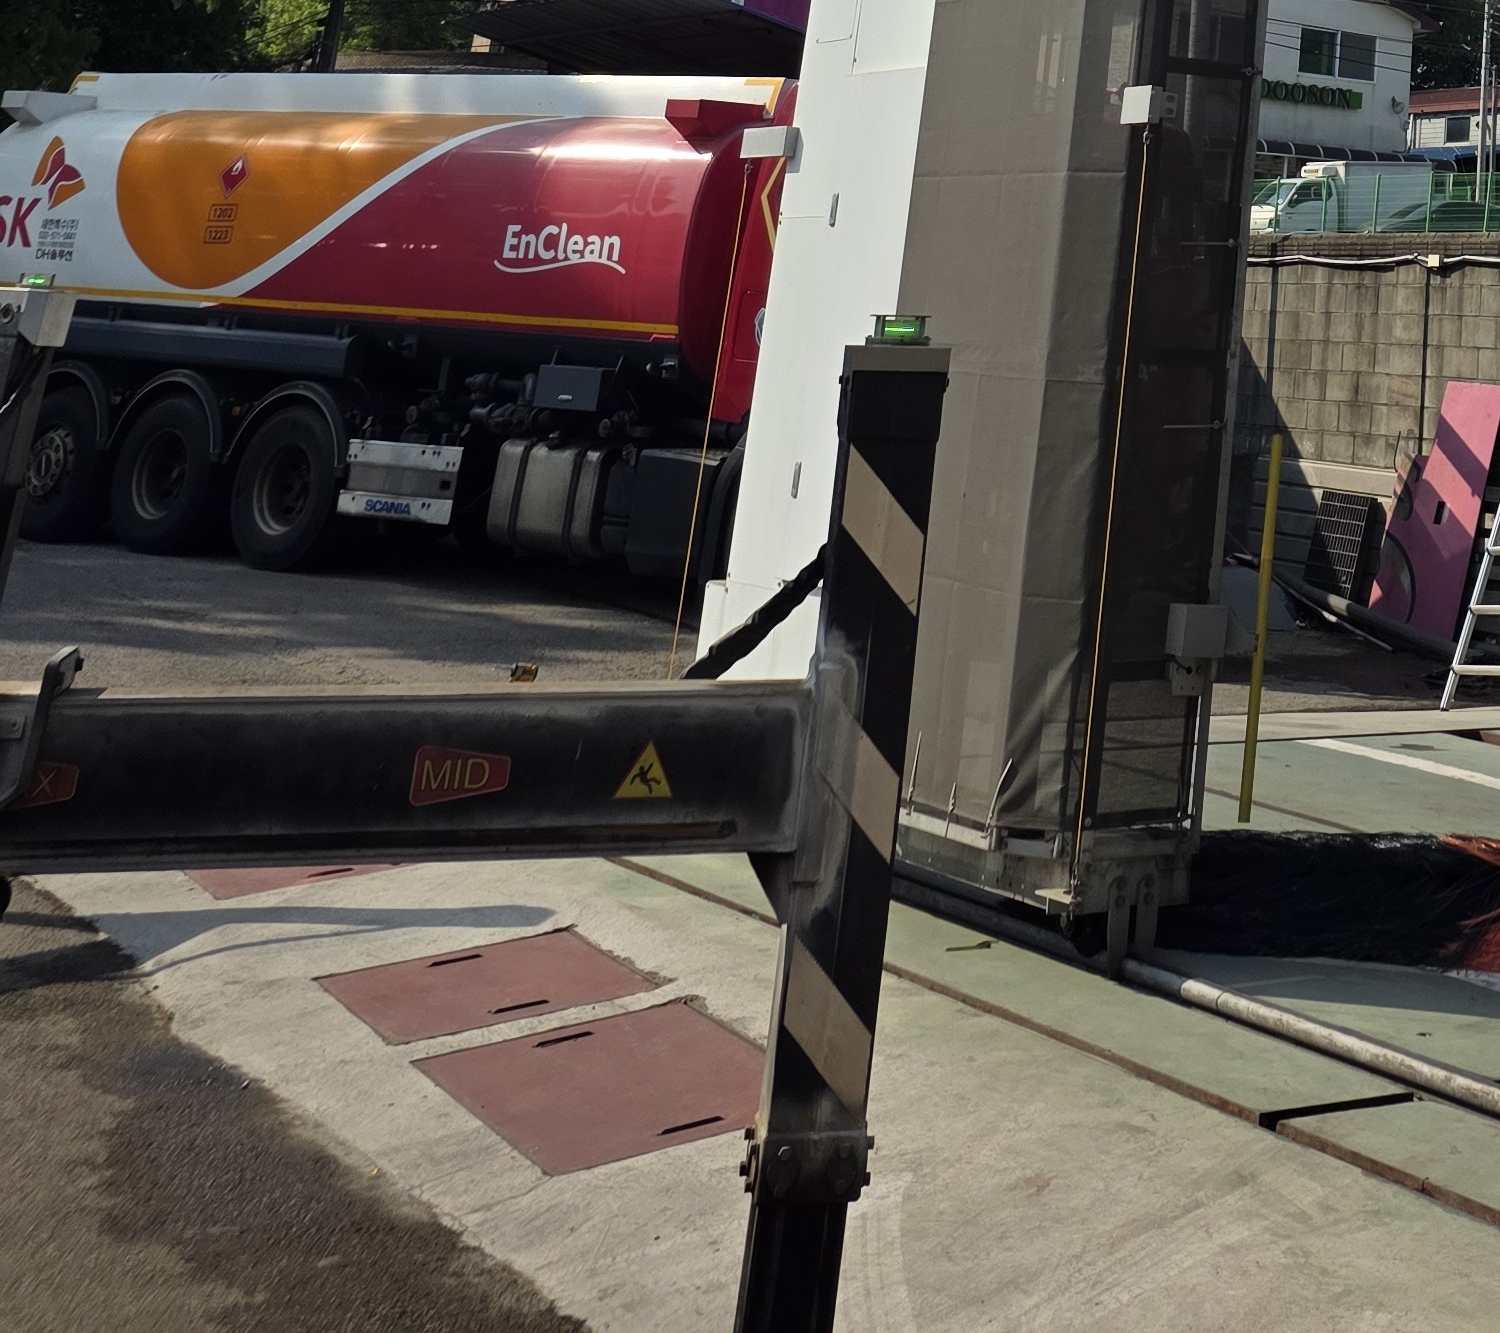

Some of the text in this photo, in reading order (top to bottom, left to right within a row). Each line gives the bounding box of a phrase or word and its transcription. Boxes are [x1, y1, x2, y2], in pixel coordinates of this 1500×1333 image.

[212, 207, 234, 219] 1202
[207, 229, 230, 241] 1223
[502, 222, 621, 262] EnClean
[364, 498, 411, 516] SCANIA
[420, 758, 490, 790] MID
